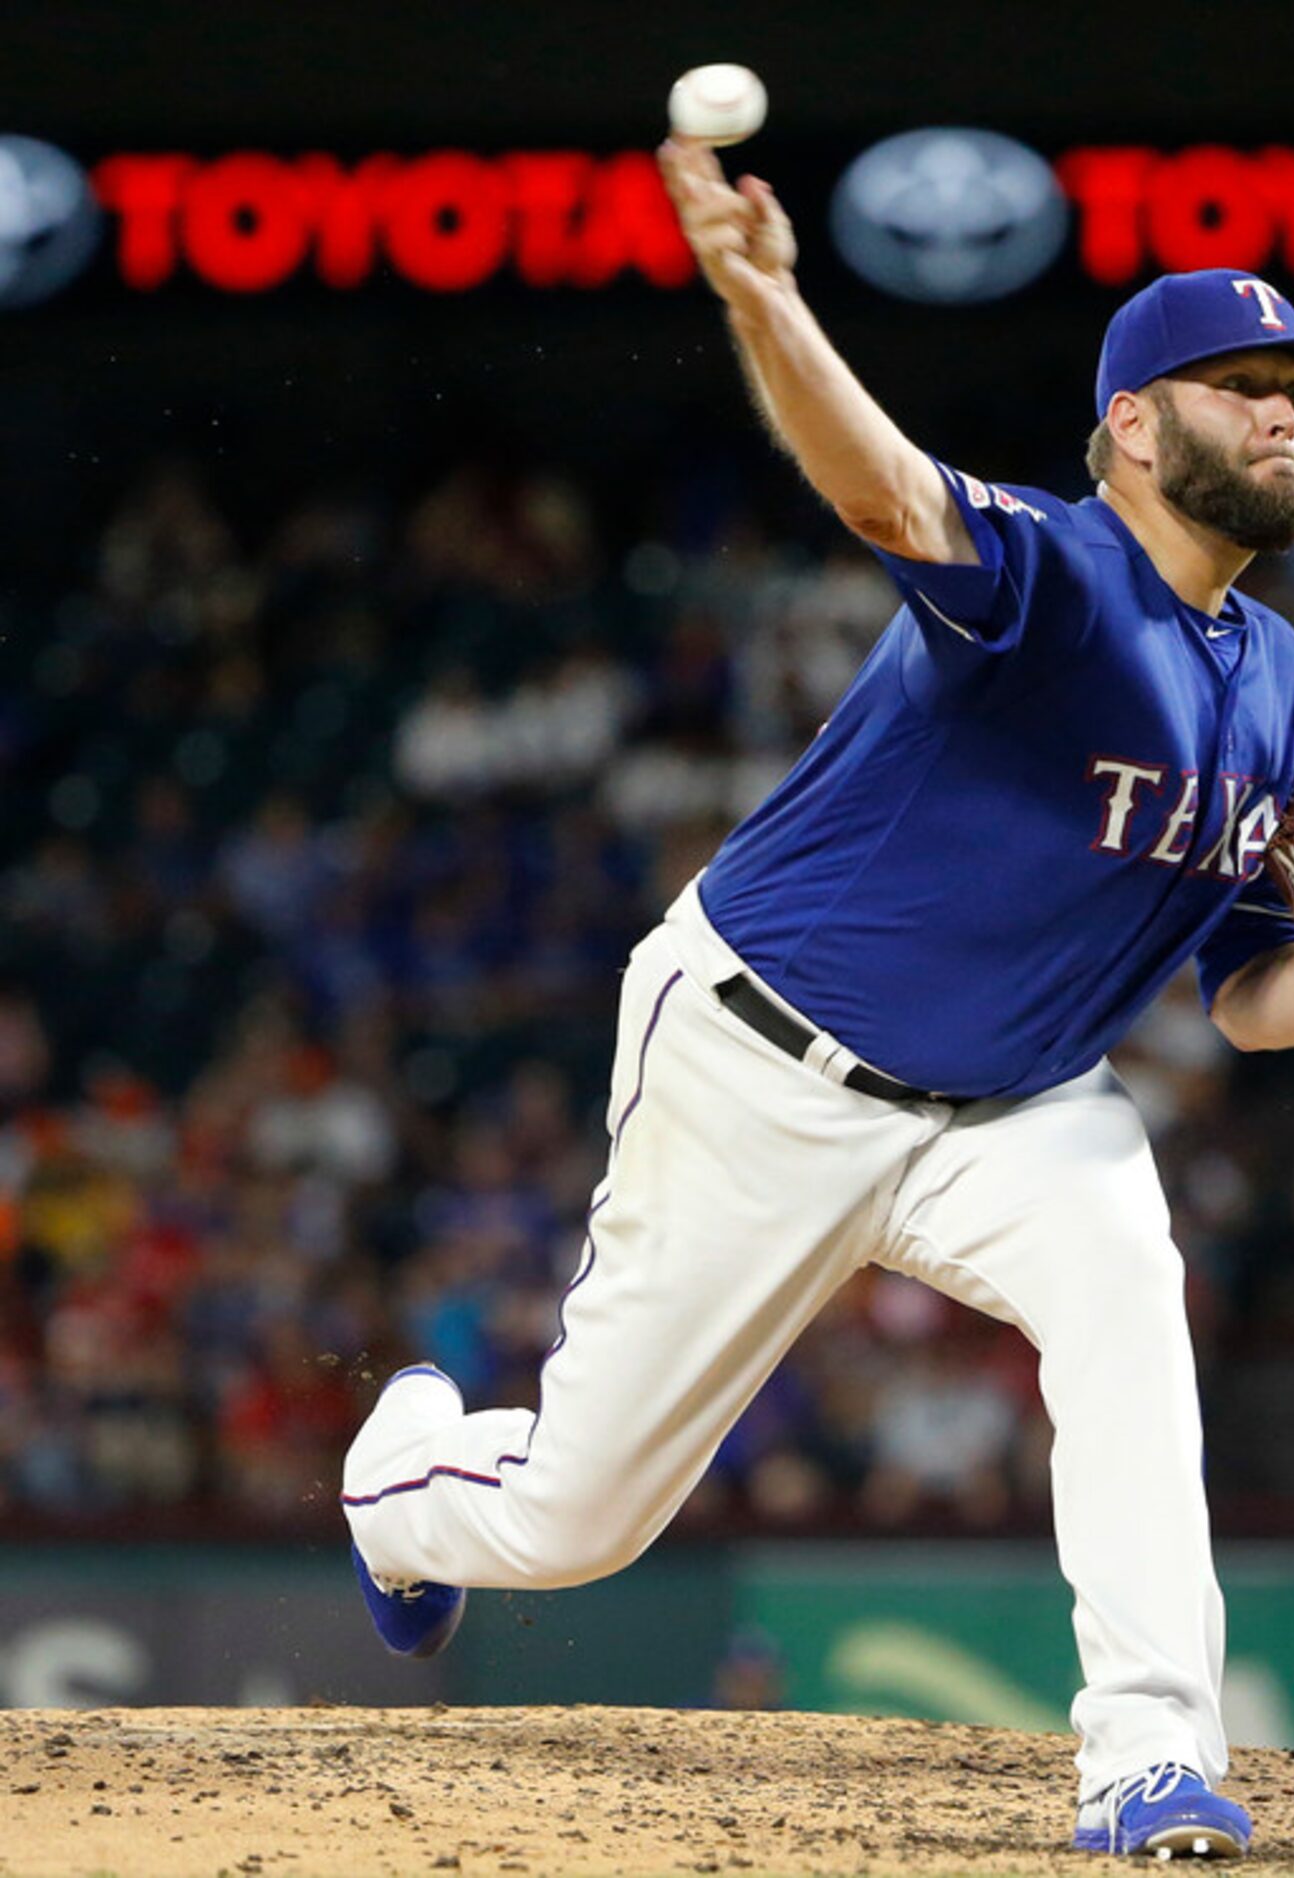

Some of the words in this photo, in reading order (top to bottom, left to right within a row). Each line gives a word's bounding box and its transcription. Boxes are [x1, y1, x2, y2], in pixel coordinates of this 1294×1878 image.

[94, 149, 700, 292] TOYOTA
[1231, 279, 1286, 331] T
[1087, 754, 1281, 883] TEXA
